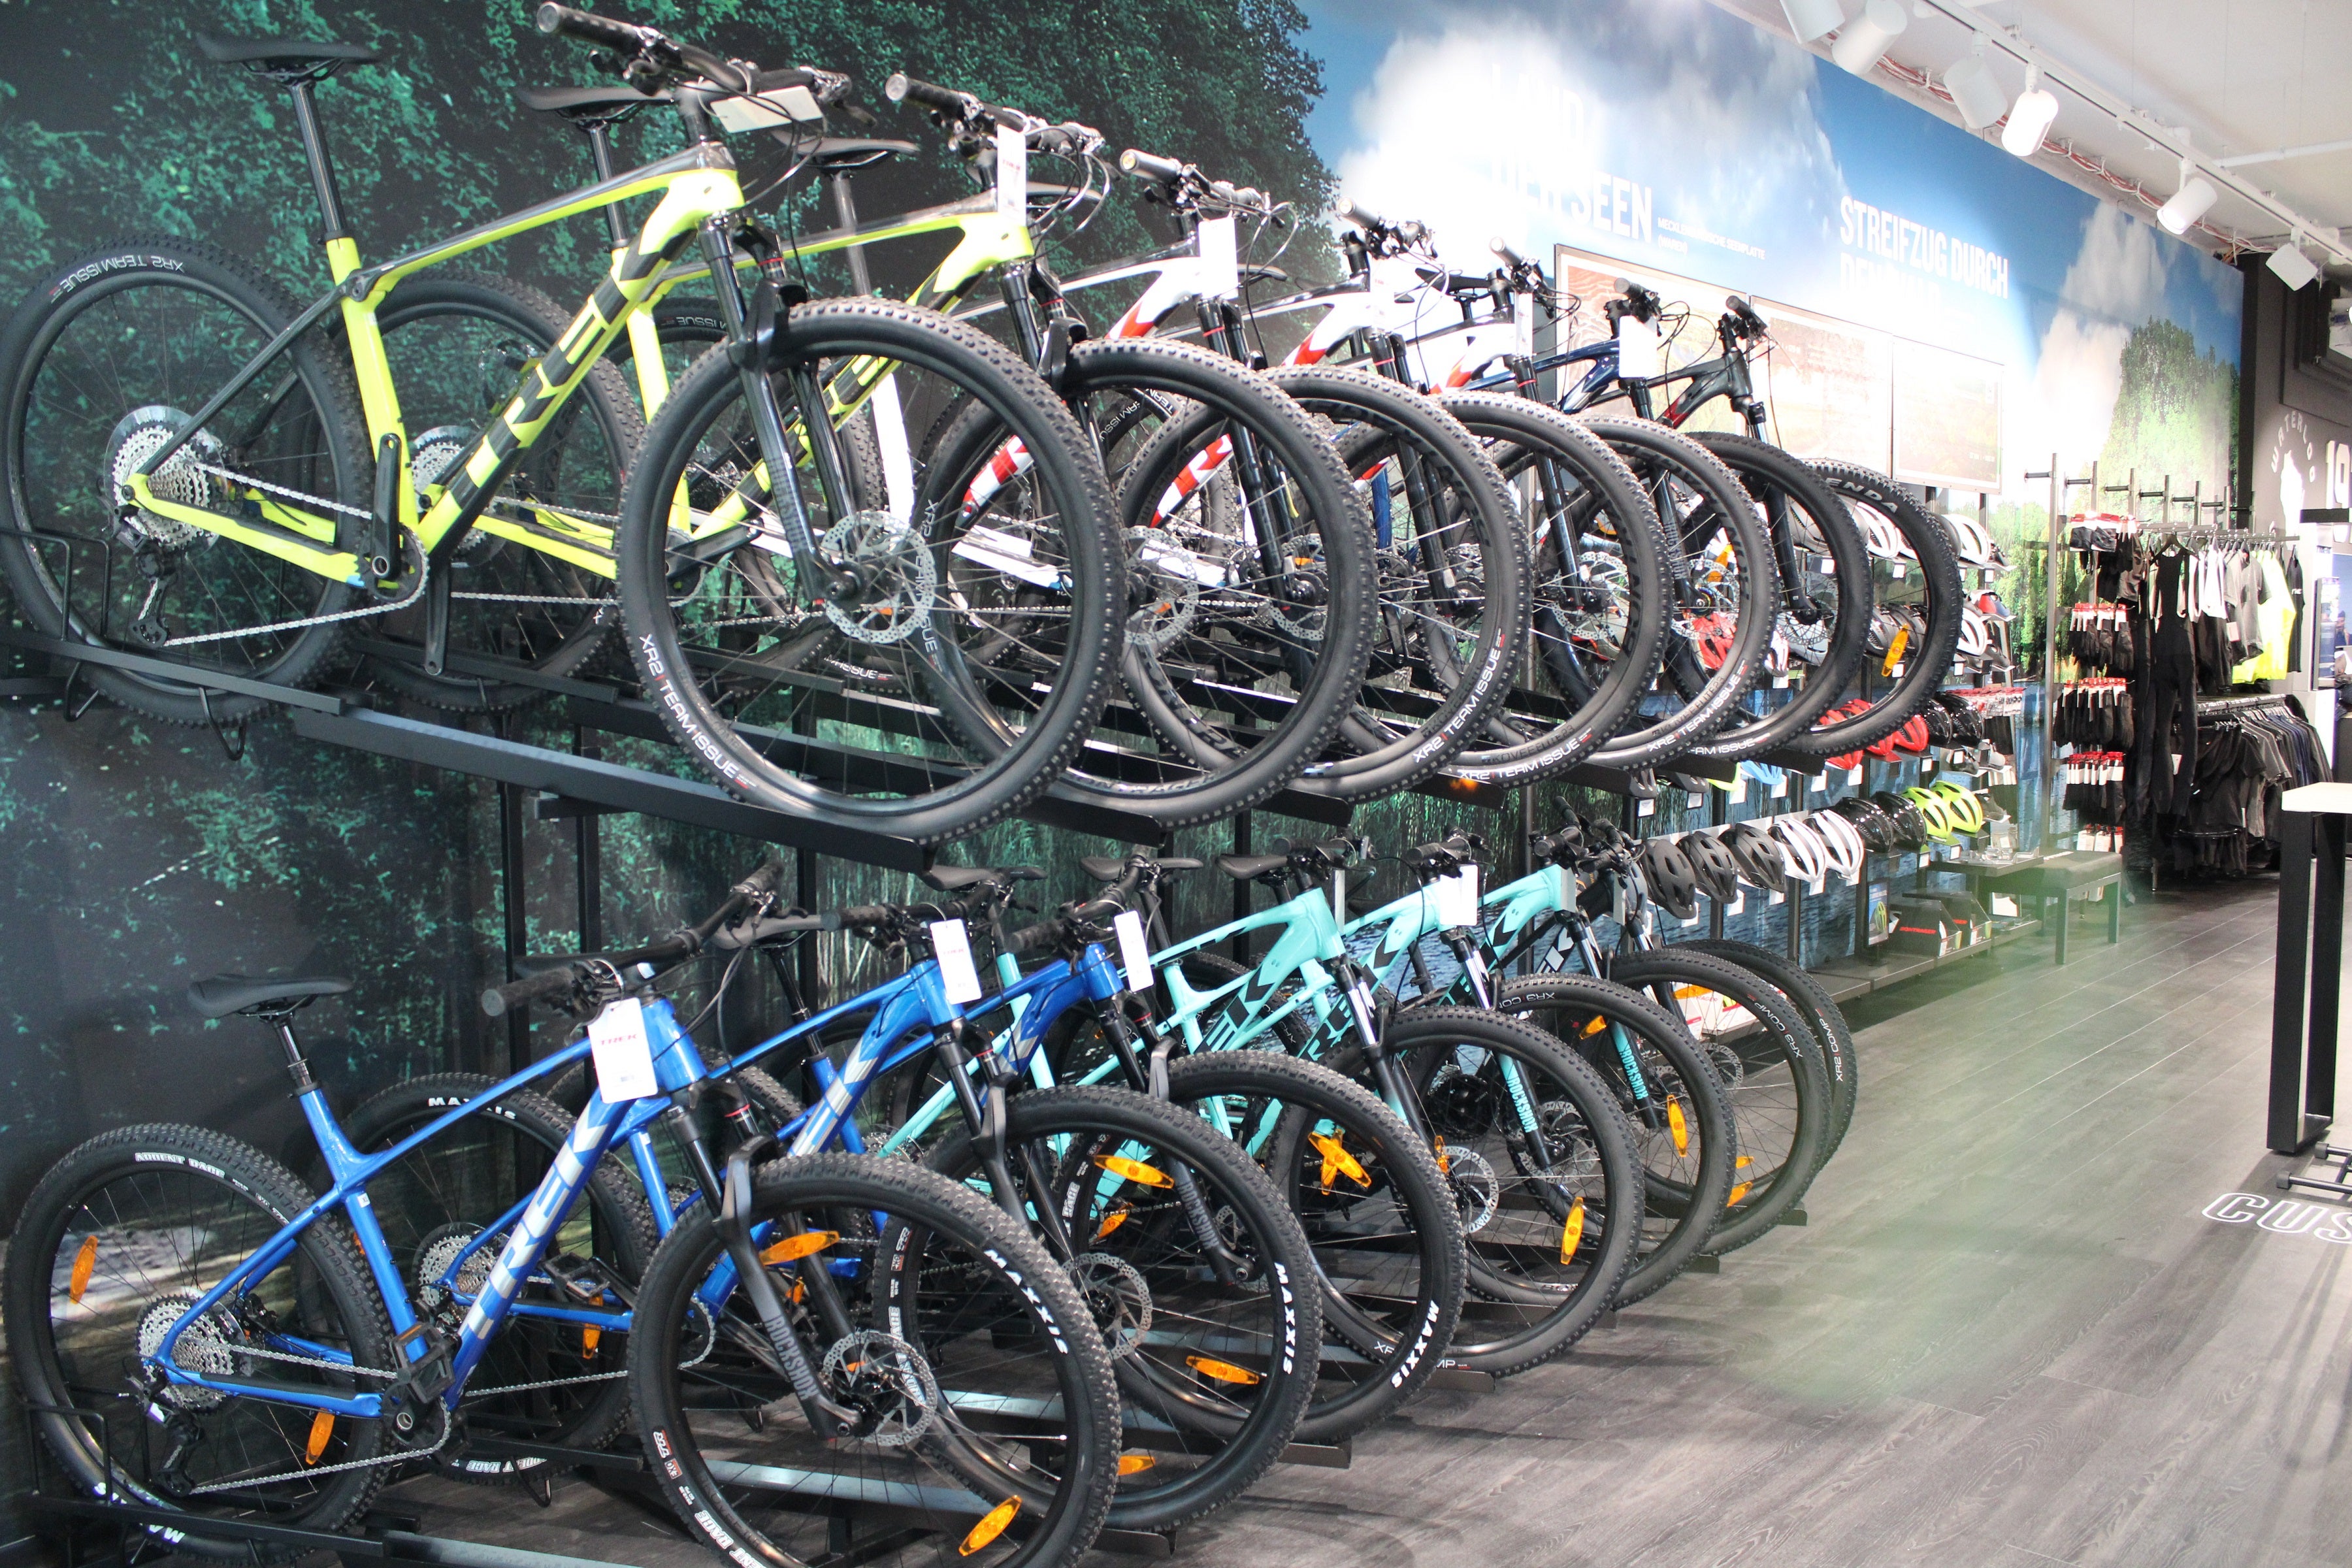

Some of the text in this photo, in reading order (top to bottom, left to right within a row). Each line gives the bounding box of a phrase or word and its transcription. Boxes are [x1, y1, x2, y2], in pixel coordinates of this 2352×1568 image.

[1571, 165, 1652, 244] SEEN
[59, 255, 185, 293] XR2 TEAM ISSUE
[1840, 195, 2008, 299] STREIFZUG DURCH
[676, 316, 717, 328] ISSUE
[444, 229, 661, 513] TREK
[1100, 416, 1121, 442] ISSU
[2271, 410, 2316, 483] WATERLOO
[1826, 478, 1898, 514] ENDA
[639, 633, 665, 677] XR2
[659, 679, 698, 734] TEAM
[691, 731, 740, 779] ISSUE
[1413, 647, 1501, 763] XR2 TEAM ISSUE
[1647, 674, 1741, 752] XR2 TEAM ISSUE
[1458, 738, 1580, 780] XR2 TEAM ISSUE
[1718, 738, 1756, 754] ISSUE
[1499, 992, 1555, 1009] XR3 CO
[601, 1034, 637, 1045] TREK
[1754, 1002, 1803, 1059] XR3 COMP
[1818, 1019, 1844, 1083] XR2 COMP
[1620, 1048, 1649, 1100] ROCKSHOX
[428, 1097, 516, 1120] MAIS
[1507, 1076, 1539, 1134] ROCKSHOX
[457, 1099, 608, 1340] TREK
[984, 1249, 1068, 1354] MAXXIS
[1274, 1262, 1296, 1375] MAXXIS
[764, 1316, 819, 1401] ROCKSHOX
[1374, 1341, 1394, 1354] XR
[1391, 1299, 1439, 1388] MAXXIS
[694, 1510, 734, 1550] RACE
